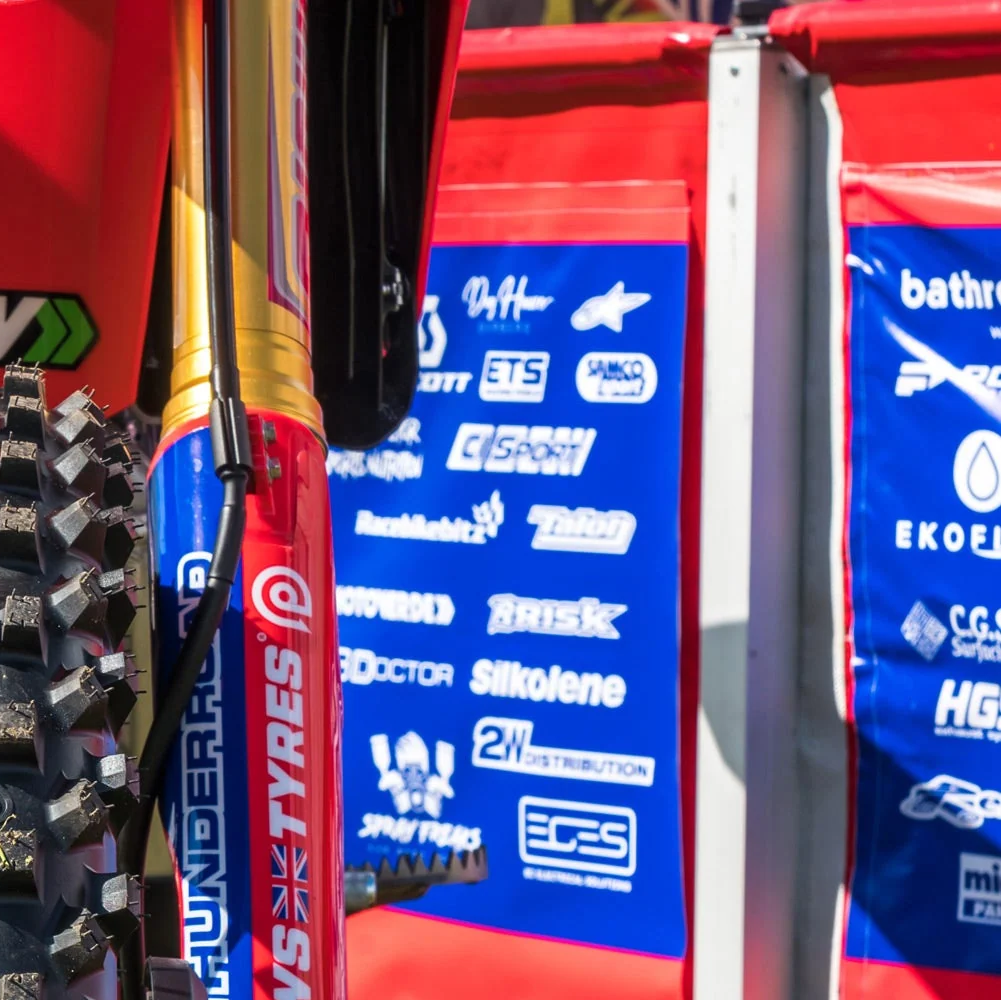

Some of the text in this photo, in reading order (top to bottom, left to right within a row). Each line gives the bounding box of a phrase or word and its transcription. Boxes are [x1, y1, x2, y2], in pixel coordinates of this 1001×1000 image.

[901, 268, 1001, 310] bathr
[487, 358, 543, 383] ETS
[469, 659, 627, 708] Silkolene
[934, 678, 1001, 730] HG
[265, 644, 307, 839] TYRES
[524, 750, 648, 778] DISTRIBUTION
